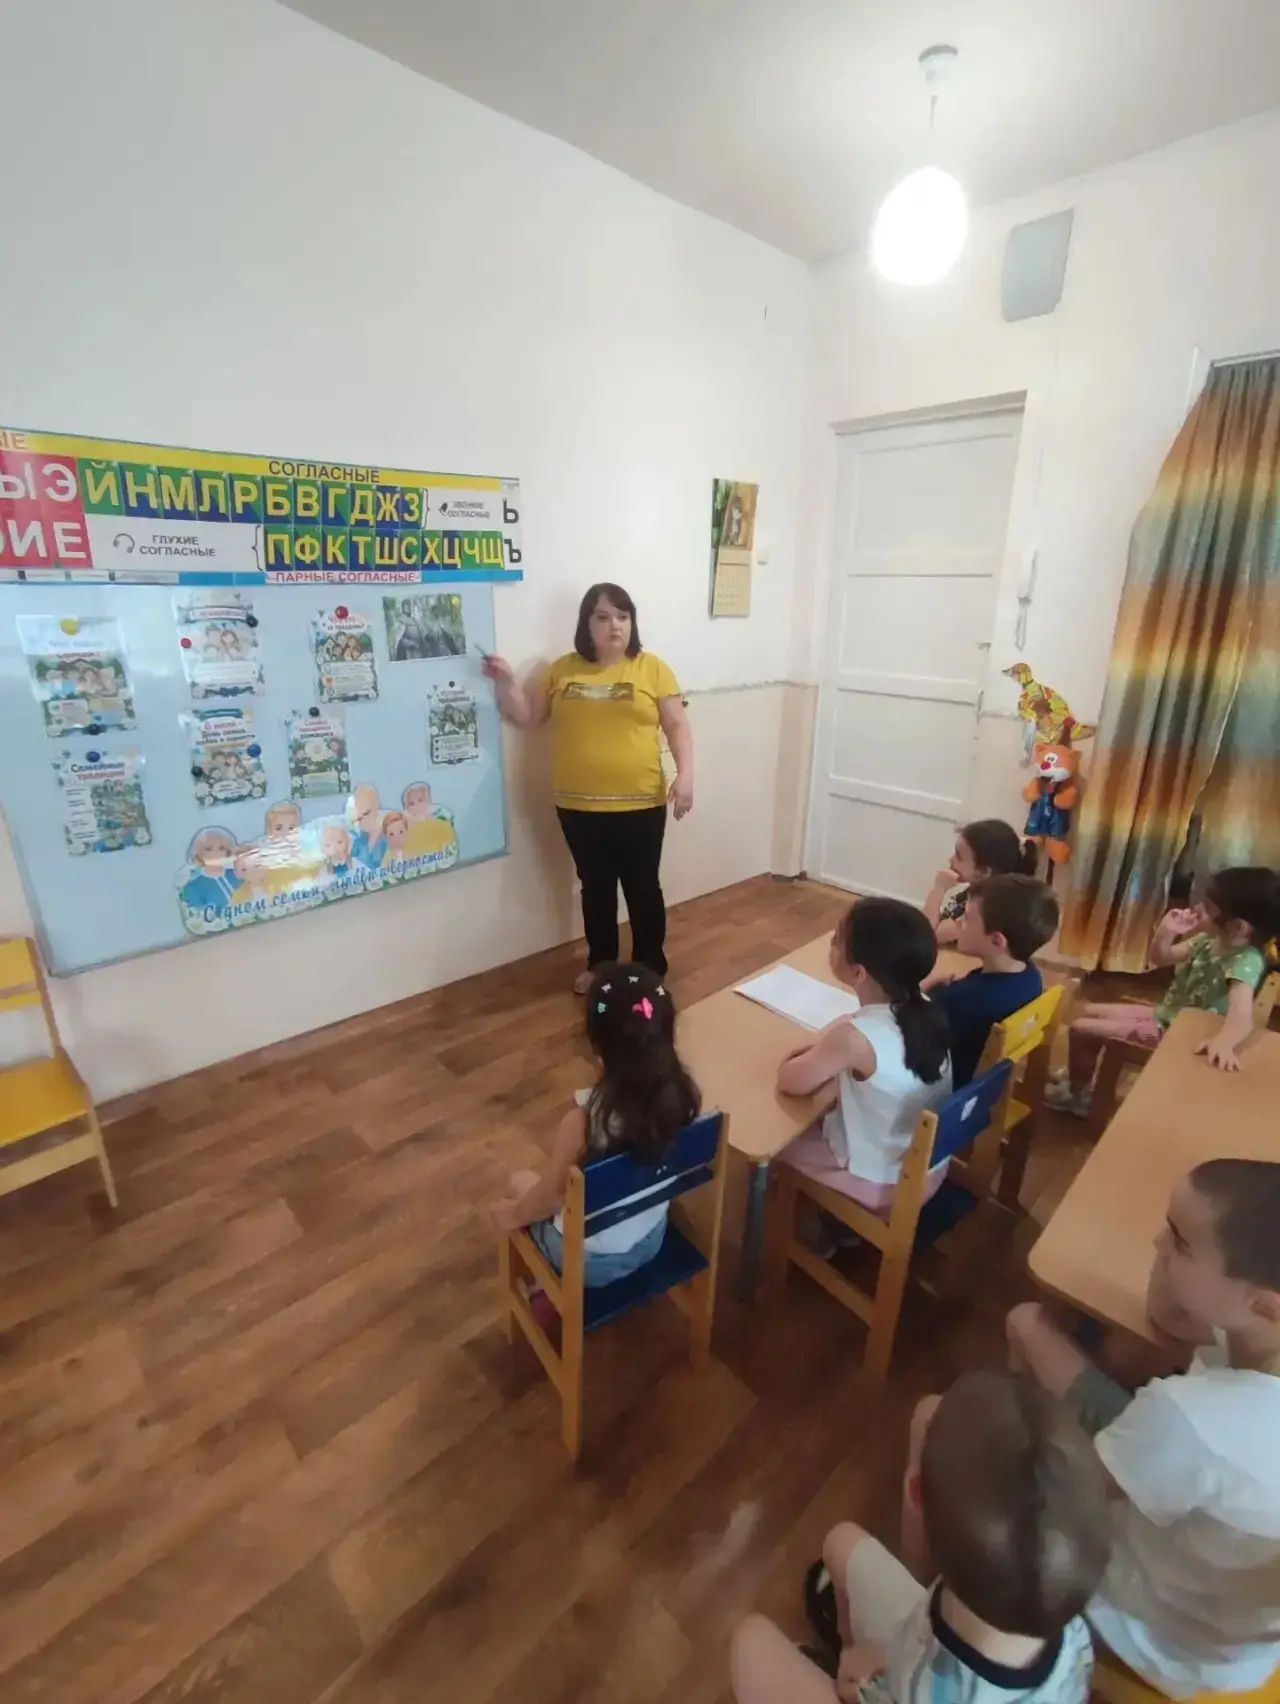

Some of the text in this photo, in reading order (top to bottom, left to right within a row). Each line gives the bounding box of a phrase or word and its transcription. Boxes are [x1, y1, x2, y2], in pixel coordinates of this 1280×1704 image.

[268, 460, 380, 483] СОГЛАСНЫЕ
[448, 510, 490, 519] СОГЛАСНЫЕ
[152, 534, 199, 545] ГЛУХИЕ
[139, 546, 216, 557] СОГЛАСНЫЕ
[276, 572, 415, 582] ПАРНЫЕ СОГЛАСНЫЕ
[204, 904, 214, 923] С
[224, 898, 266, 920] днем
